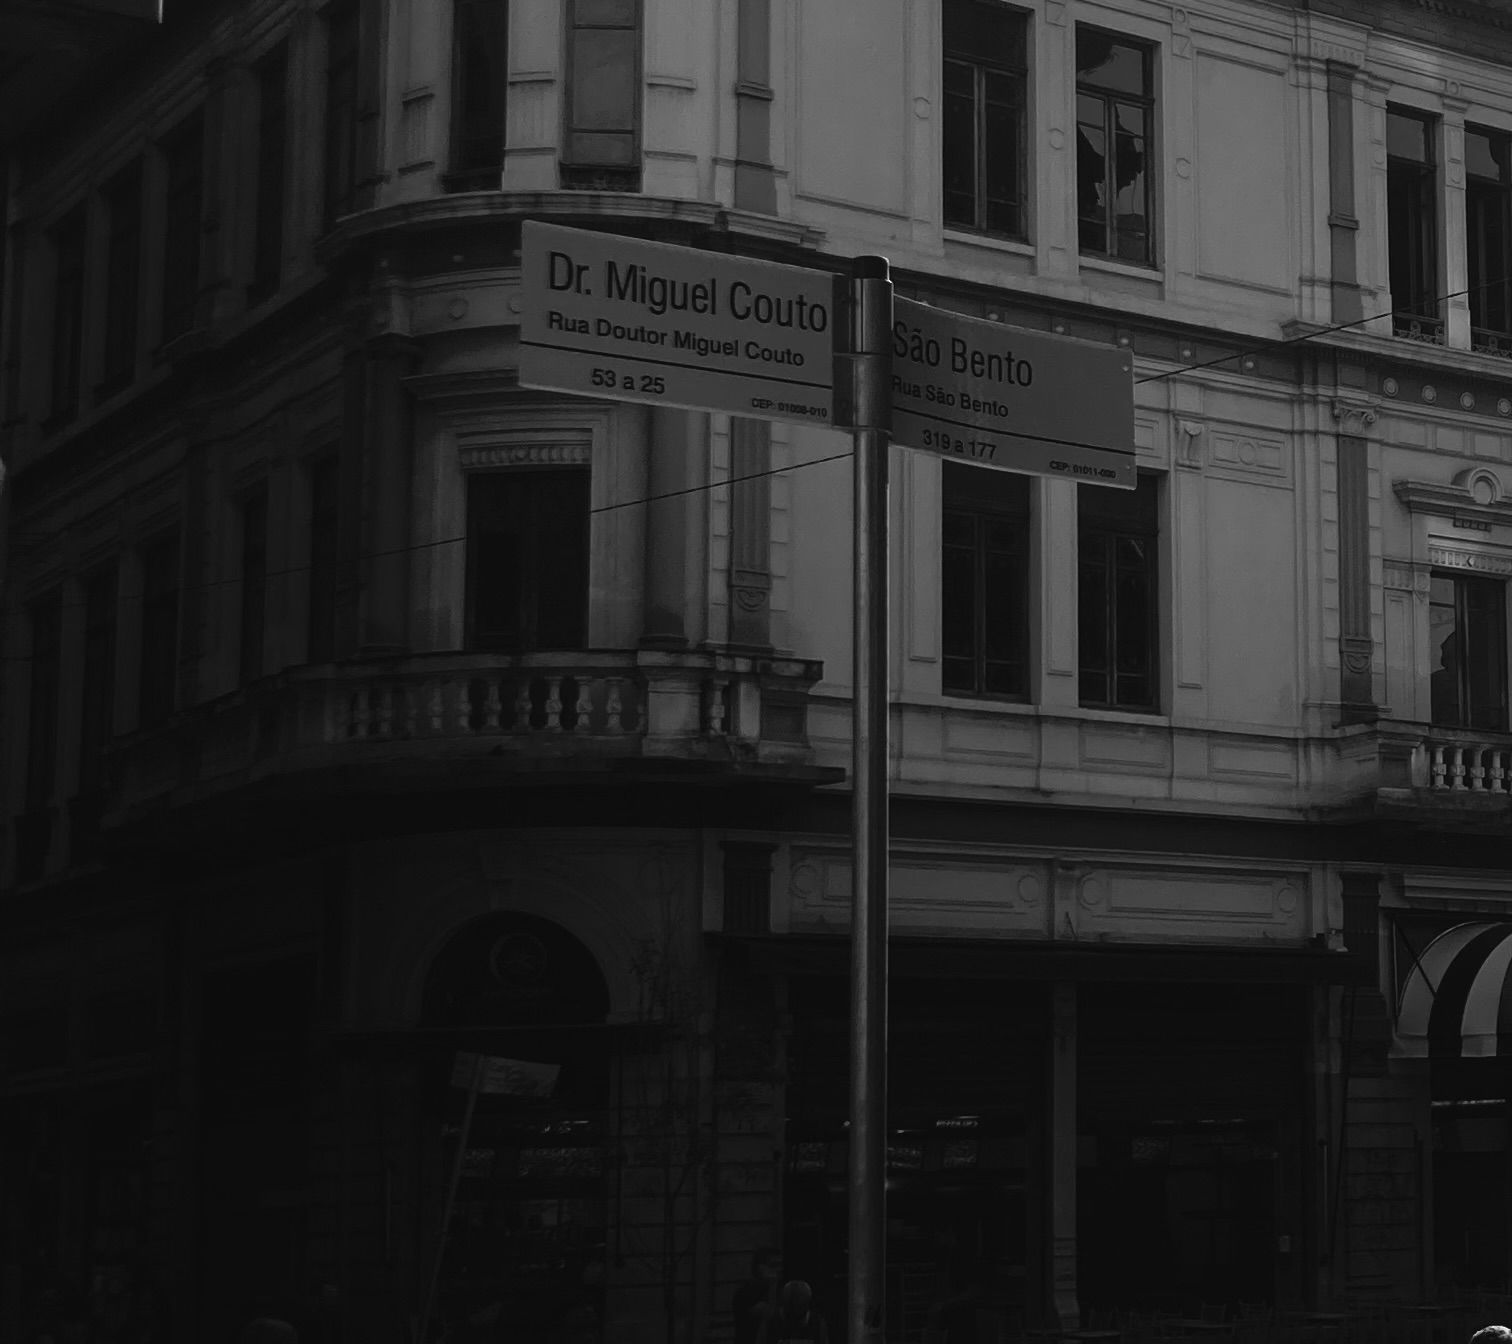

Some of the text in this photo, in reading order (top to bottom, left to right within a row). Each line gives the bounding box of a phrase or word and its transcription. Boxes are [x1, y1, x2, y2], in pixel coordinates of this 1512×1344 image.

[549, 251, 827, 332] Dr. Miguel Couto
[548, 310, 805, 367] Rua Doutor Miguel Couto
[894, 321, 1033, 387] São Bento
[591, 368, 666, 395] 53 a 25
[892, 375, 1009, 418] Rua São Bento
[922, 429, 998, 460] 319 a 177
